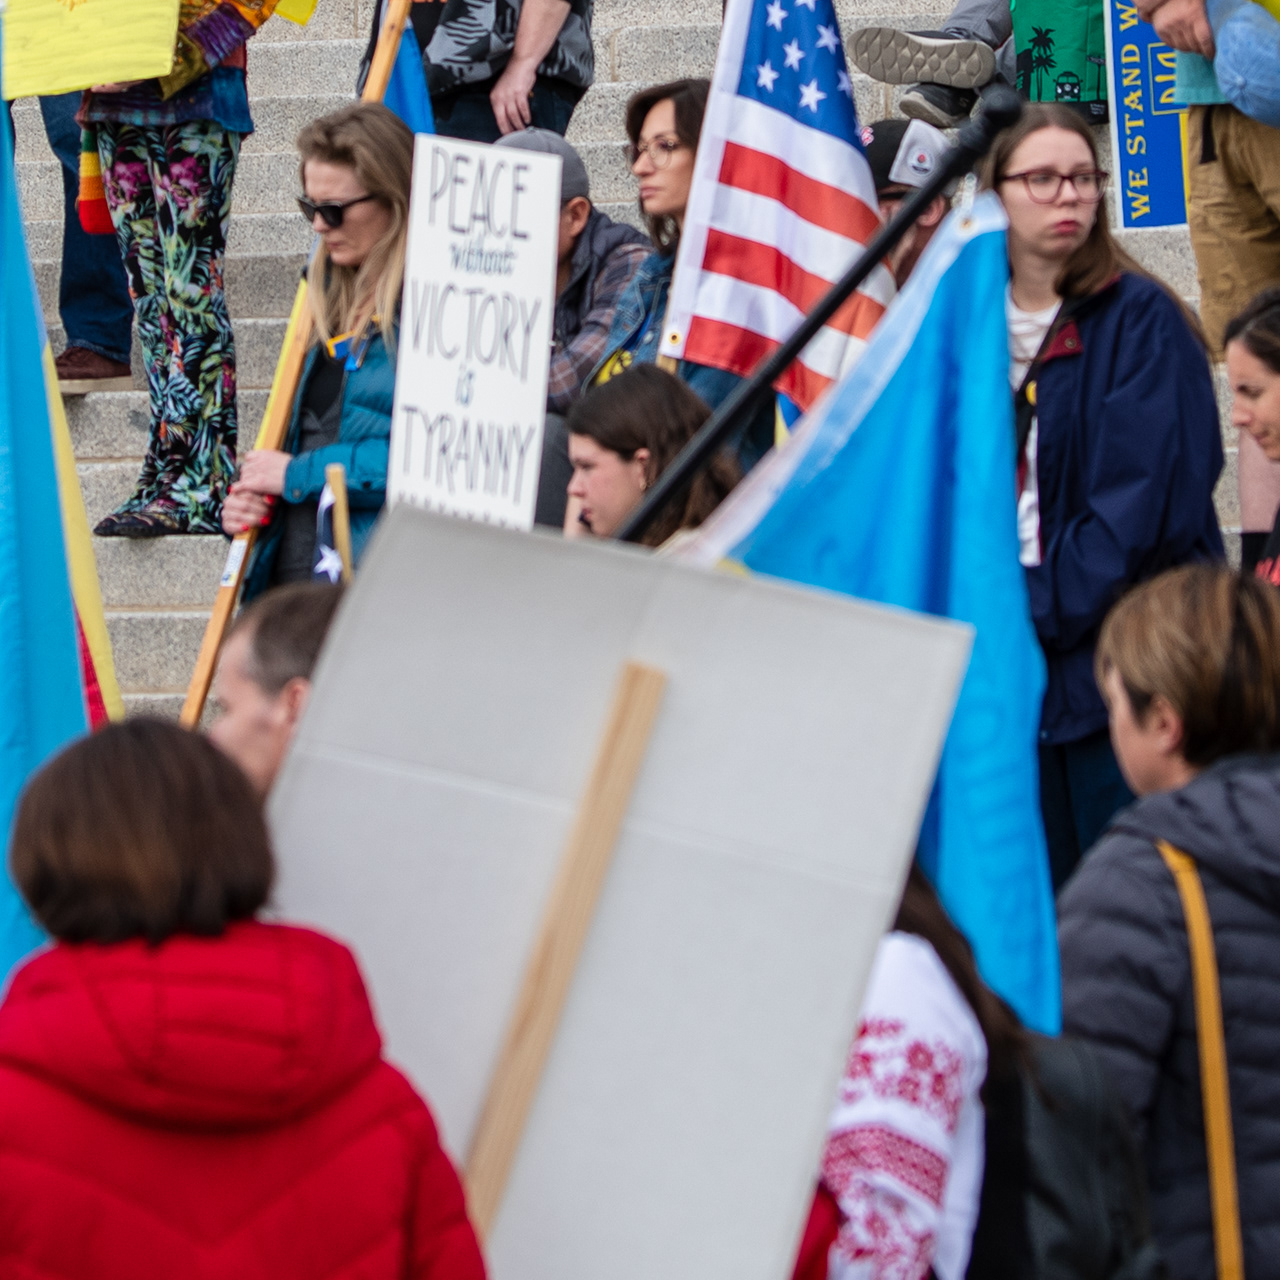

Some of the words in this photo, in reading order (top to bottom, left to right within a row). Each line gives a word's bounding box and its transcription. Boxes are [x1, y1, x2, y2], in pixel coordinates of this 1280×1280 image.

[1121, 43, 1147, 155] STAND
[428, 144, 530, 239] PEACE
[1127, 167, 1150, 220] WE
[411, 278, 542, 384] VICTORY
[455, 362, 475, 407] is
[401, 404, 536, 505] TYRANNY
